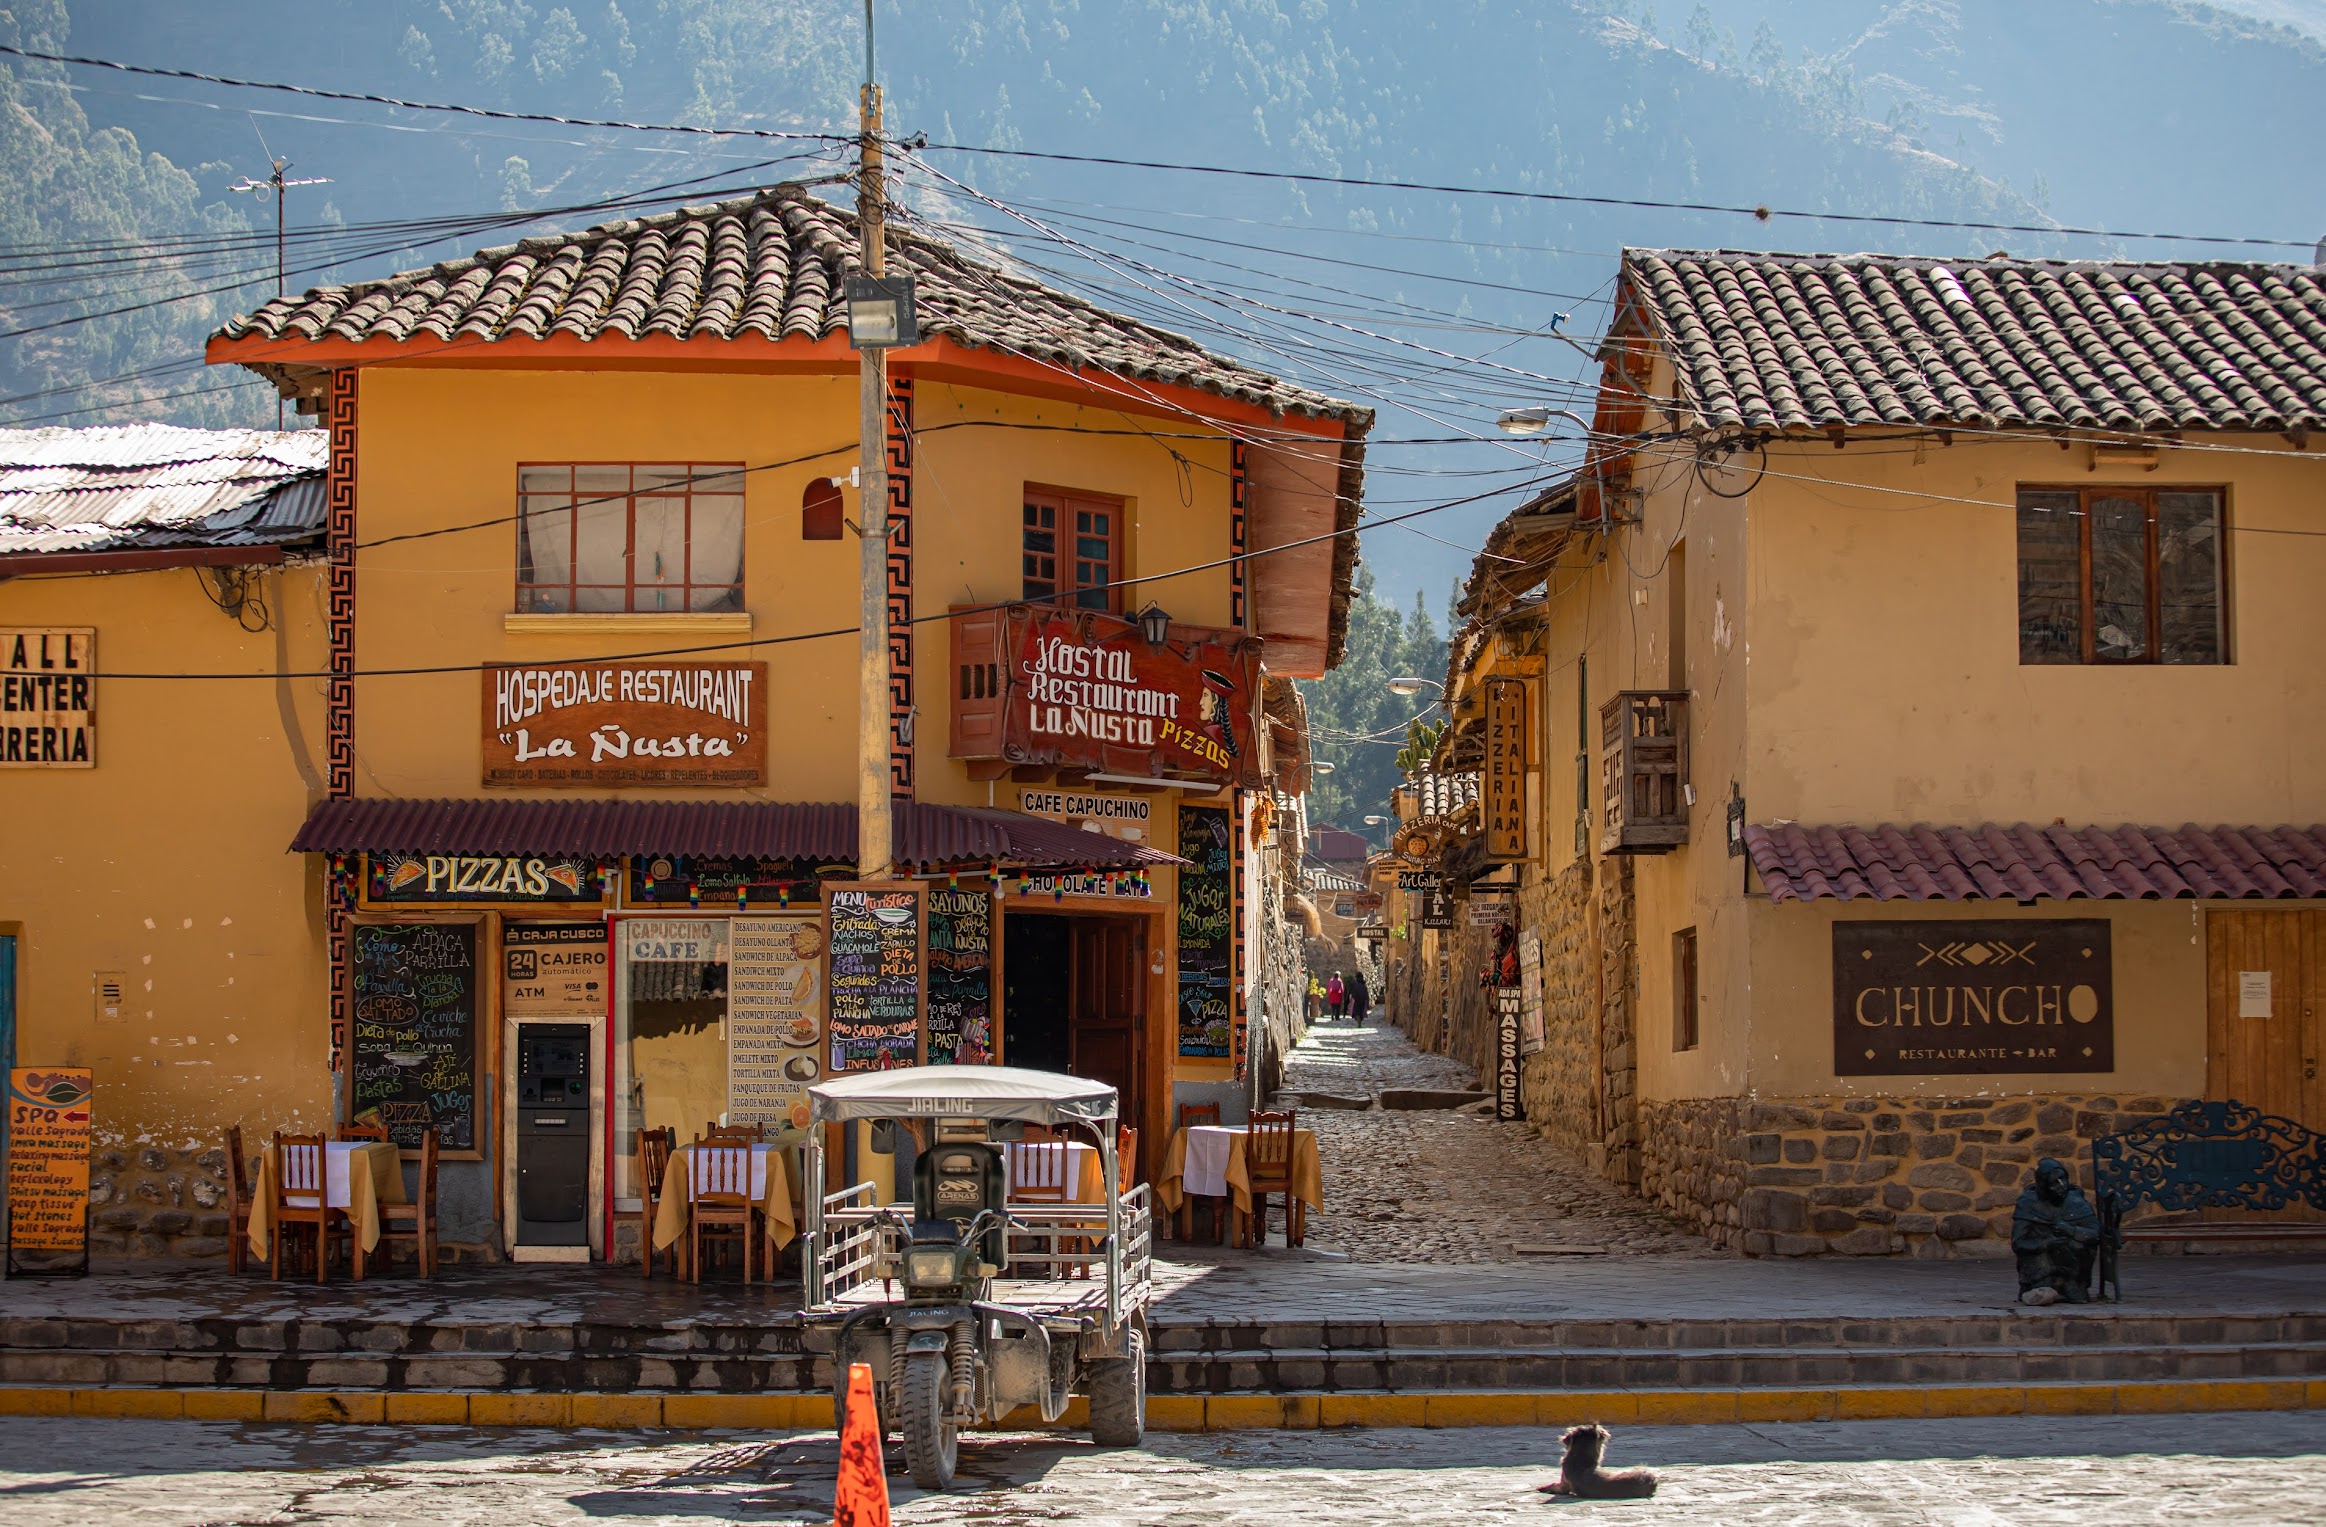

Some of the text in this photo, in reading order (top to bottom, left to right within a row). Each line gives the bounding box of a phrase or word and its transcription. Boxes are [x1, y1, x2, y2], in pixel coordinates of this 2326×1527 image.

[0, 676, 88, 711] ENTER
[1023, 661, 1180, 718] Restaurant
[497, 670, 752, 729] HOSPEDAJE RESTAURANT
[1509, 706, 1518, 850] ITALIANA
[1025, 793, 1149, 820] CAFE CAPUCHINO
[1395, 815, 1440, 841] PIZZERIA
[426, 856, 549, 895] PIZZAS
[1401, 874, 1417, 887] Art
[928, 892, 987, 914] SAYUNOS
[1186, 884, 1224, 911] JUGOS
[1179, 902, 1230, 931] NATURALES
[735, 923, 801, 933] DESAYUNO AMERICANO
[831, 915, 880, 932] Entrada
[522, 929, 604, 940] CAJA CUSCO
[632, 923, 711, 940] CAPUCCINO
[834, 930, 874, 940] NACHOS
[882, 928, 916, 936] CREMA
[364, 937, 399, 952] Lomo
[413, 934, 464, 952] ALPACA
[735, 938, 793, 947] DESAYUNO OLLANTA
[832, 942, 880, 953] GUACAMOLE
[881, 940, 915, 950] ZAPALLO
[1179, 936, 1211, 949] LIMONADA
[635, 942, 699, 959] CAFE
[735, 952, 798, 962] SANDWICH DE ALPACA
[884, 949, 915, 962] DIETA
[406, 951, 470, 969] PARRILLA
[511, 953, 606, 970] 24 CAJERO
[543, 967, 592, 975] automático
[766, 967, 785, 976] MIXTO
[881, 964, 917, 976] POLLO
[735, 982, 792, 991] SANDWICH DE POLLO
[832, 974, 877, 988] Segundos
[515, 987, 545, 998] ATM
[879, 985, 918, 995] PLANCHA
[1510, 989, 1521, 998] SPA
[370, 998, 402, 1011] LOMO
[734, 996, 793, 1006] SANDWICH DE PALTA
[835, 994, 865, 1006] POLLO
[1856, 984, 2098, 1027] CHUNCHO
[359, 1005, 414, 1022] SALTADO
[734, 1011, 803, 1020] SANDWICH VEGETARIAN
[833, 1008, 871, 1020] PLANCHA
[869, 1006, 915, 1017] VERDURAS
[1202, 1000, 1228, 1020] PIZZA
[356, 1023, 385, 1038] Dieta
[734, 1025, 793, 1035] EMPANADA DE POLLO
[830, 1018, 918, 1038] LOMO SALTADO CARNE
[928, 1018, 955, 1031] RRILLA
[734, 1040, 785, 1049] EMPANADA MIXTA
[734, 1055, 779, 1064] OMELETE MIXTO
[1500, 999, 1519, 1118] MASSAGES
[1899, 1048, 2057, 1060] RESTAURANTE BAR
[733, 1069, 780, 1079] TORTILLA MIXTA
[421, 1073, 472, 1091] GALLINA
[733, 1084, 801, 1095] PANQUEQUE DE FRUTAS
[431, 1091, 472, 1113] JUGOS
[733, 1098, 787, 1108] JUGO DE NARANJA
[908, 1098, 974, 1114] JIALING
[382, 1101, 433, 1122] PIZZA
[733, 1112, 777, 1122] JUGO DE FRESA
[762, 1128, 780, 1137] ANGO
[10, 1160, 48, 1172] Facial
[940, 1192, 977, 1200] ARENAS
[907, 1309, 950, 1318] JIALING
